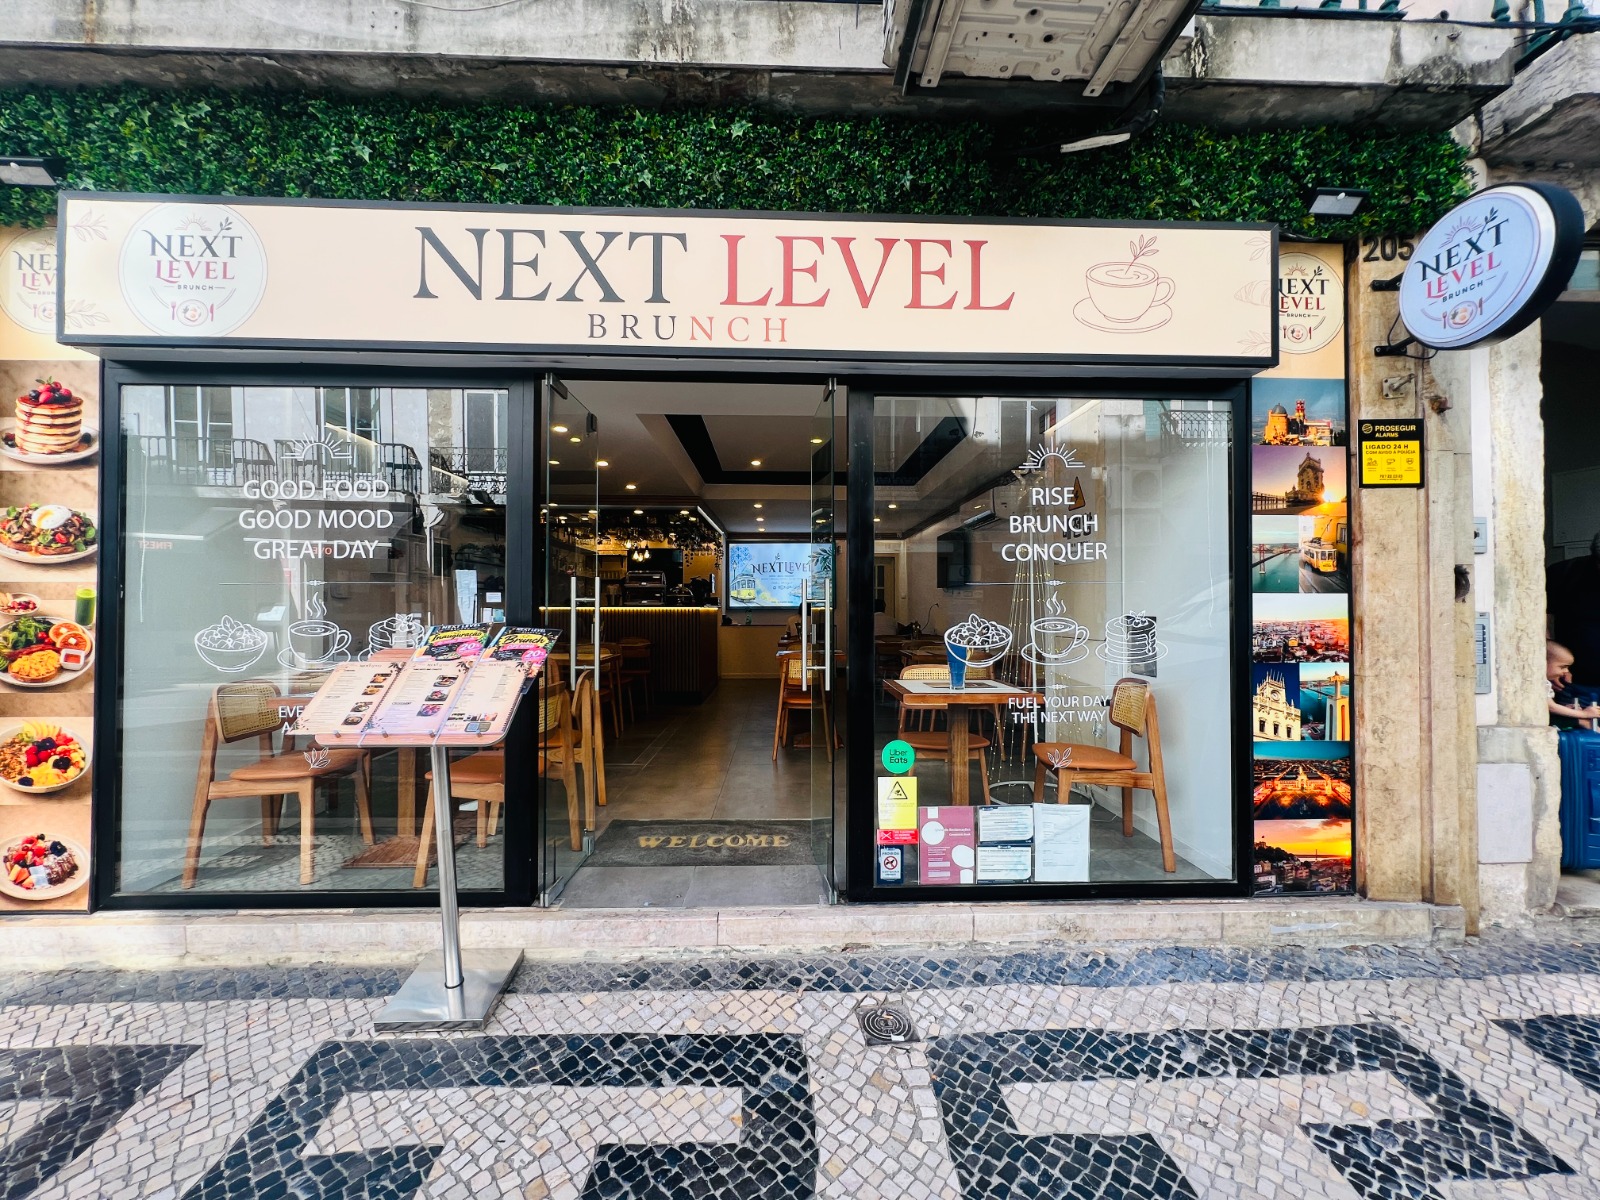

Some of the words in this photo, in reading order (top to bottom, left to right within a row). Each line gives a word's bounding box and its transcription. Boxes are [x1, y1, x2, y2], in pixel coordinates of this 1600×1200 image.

[141, 229, 243, 262] NEXT
[1362, 236, 1414, 261] 205
[1414, 217, 1509, 282] NEXT
[12, 250, 57, 275] NE
[156, 260, 236, 284] LEVEL
[413, 226, 687, 303] NEXT
[720, 235, 1015, 310] LEVEL
[22, 272, 57, 290] LEV
[1427, 251, 1502, 298] LEVEL
[1442, 280, 1484, 303] BRUNCH
[1279, 296, 1326, 313] EVEL
[588, 313, 788, 342] BRUNCH
[243, 480, 316, 500] GOOD
[322, 479, 390, 499] FOOD
[1032, 487, 1075, 506] RISE
[238, 509, 311, 529] GOOD
[318, 509, 394, 529] MOOD
[1009, 514, 1098, 534] BRUNCH
[254, 540, 328, 559] GREAT
[333, 540, 379, 559] DAY
[1001, 542, 1108, 563] CONQUER
[501, 634, 546, 645] Brunch
[1008, 697, 1041, 709] FUEL
[1043, 696, 1080, 709] YOUR
[1083, 695, 1110, 707] DAY
[1011, 711, 1038, 724] THE
[1041, 711, 1075, 723] NEXT
[1077, 710, 1106, 722] WAY
[638, 833, 792, 849] WELCOME
